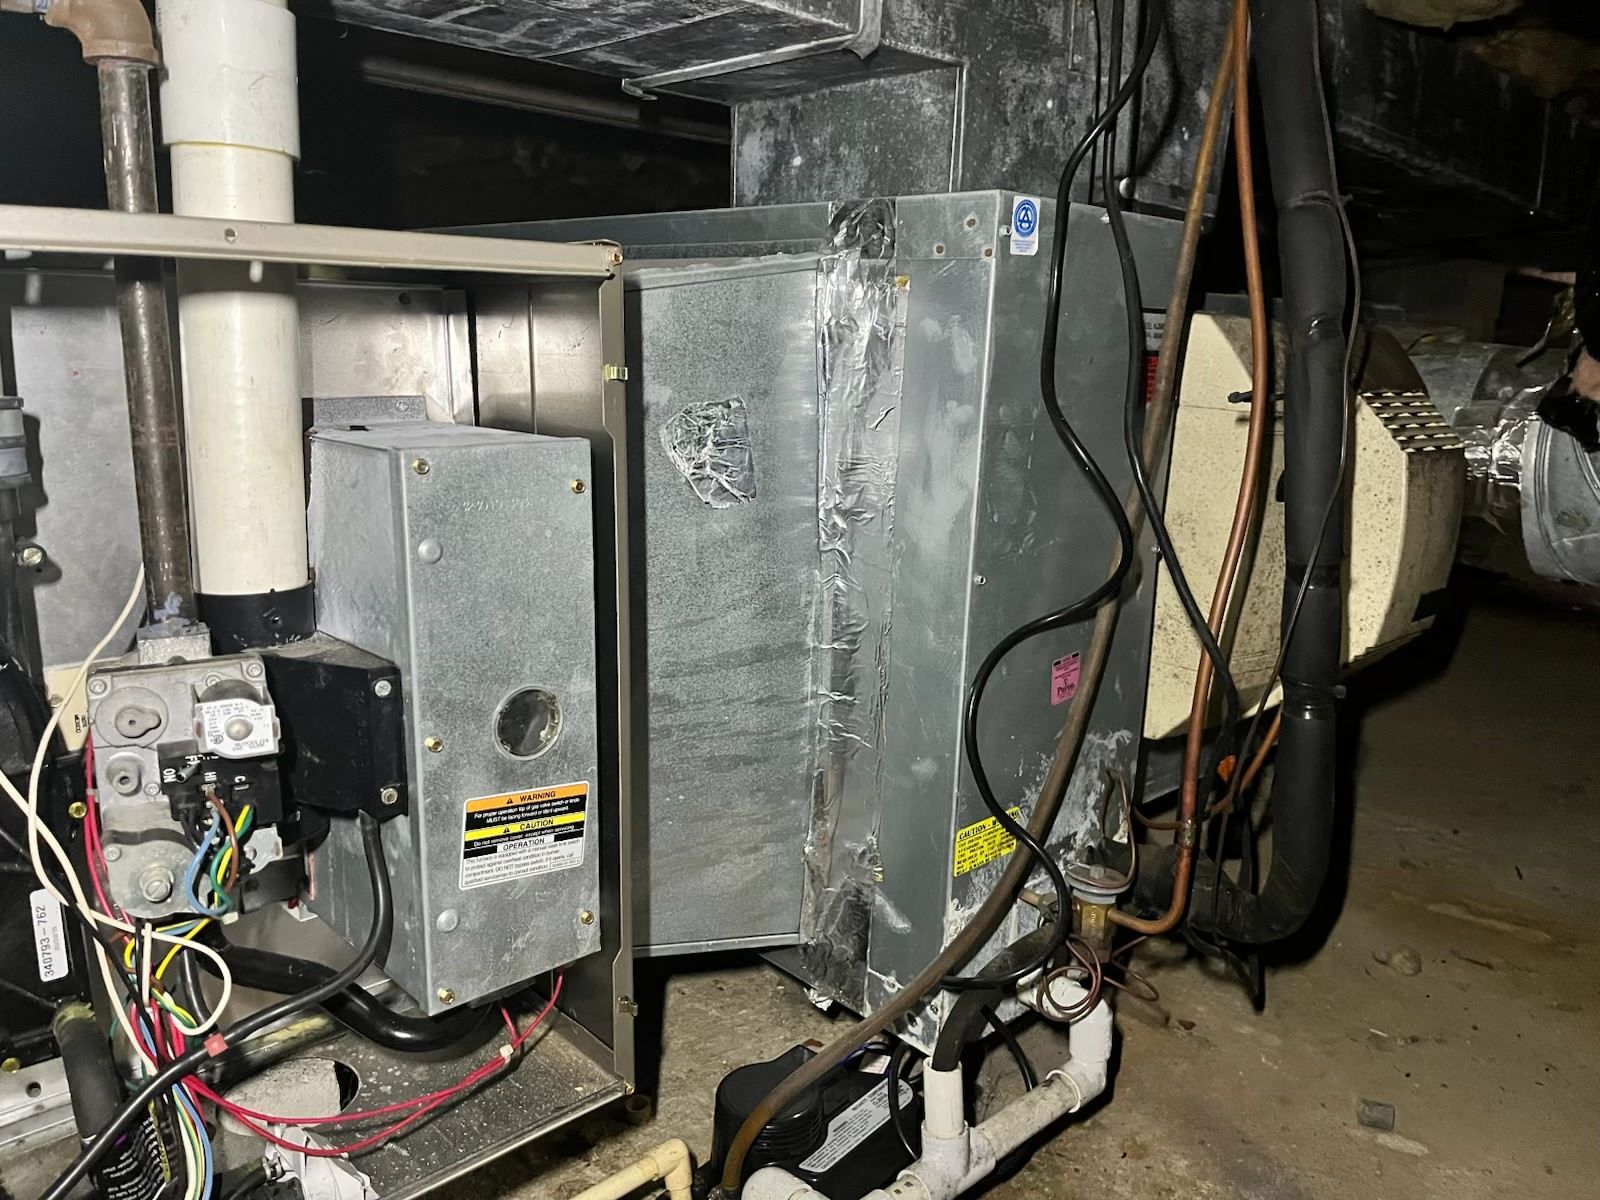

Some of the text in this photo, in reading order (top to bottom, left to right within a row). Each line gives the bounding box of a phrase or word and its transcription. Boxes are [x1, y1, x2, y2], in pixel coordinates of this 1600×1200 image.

[163, 768, 177, 783] ON
[204, 771, 217, 782] HI
[520, 791, 556, 802] WARNING
[520, 819, 554, 830] CAUTION
[959, 824, 986, 839] CAUTION
[503, 838, 545, 850] OPERATION
